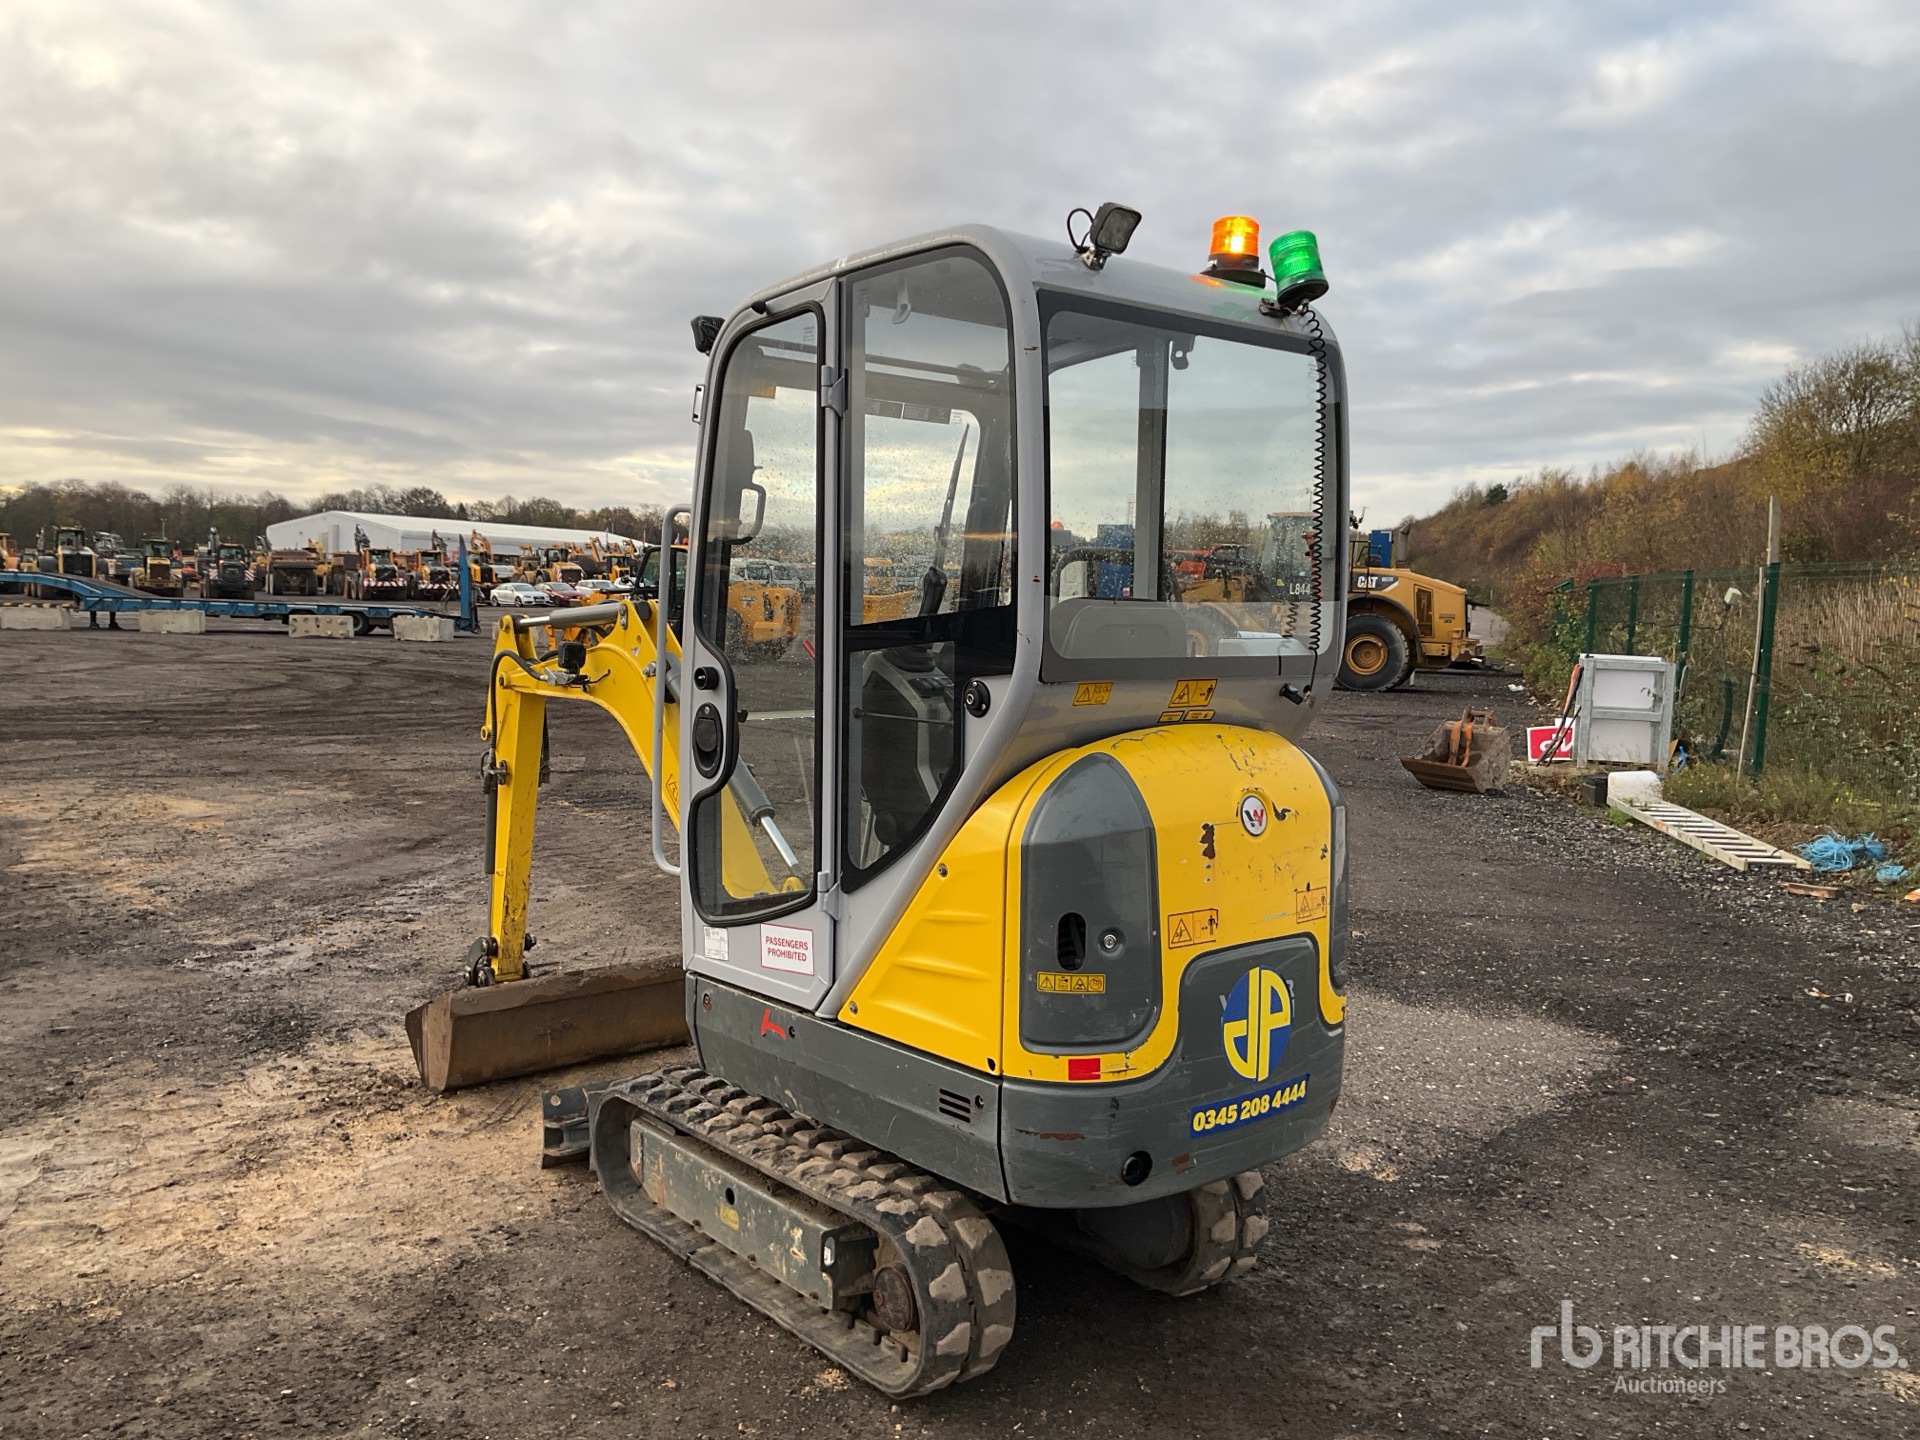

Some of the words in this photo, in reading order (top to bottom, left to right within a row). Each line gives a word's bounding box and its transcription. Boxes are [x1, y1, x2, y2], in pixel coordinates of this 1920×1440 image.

[1357, 575, 1378, 589] CAT
[765, 935, 809, 950] PASSENGERS
[767, 947, 807, 962] PROHIBITED
[1192, 1103, 1238, 1132] 0345
[1240, 1094, 1270, 1120] 208
[1271, 1079, 1306, 1109] 4444
